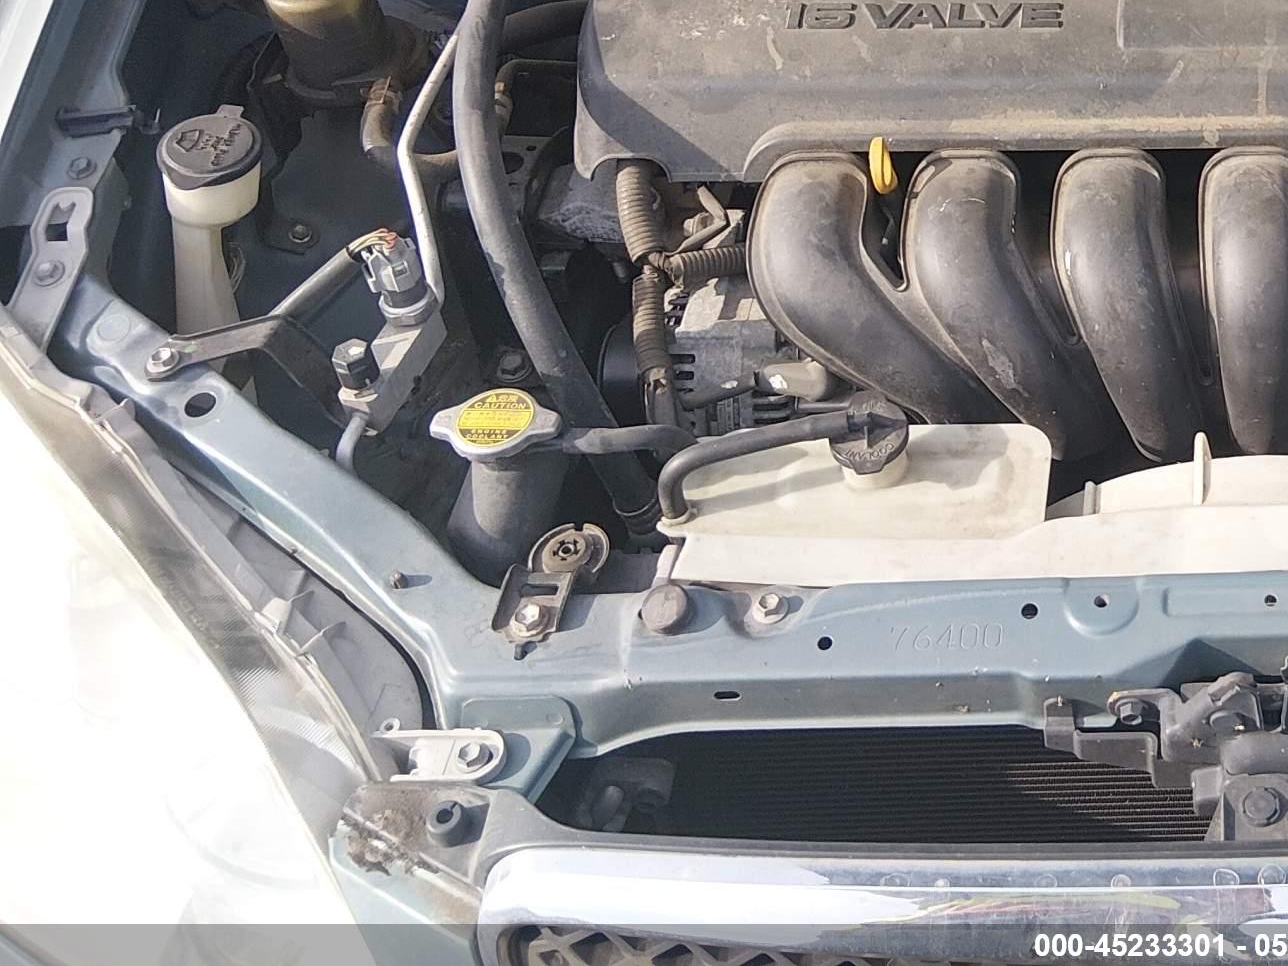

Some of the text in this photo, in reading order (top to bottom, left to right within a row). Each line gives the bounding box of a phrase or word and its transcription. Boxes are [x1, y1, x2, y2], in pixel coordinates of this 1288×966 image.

[785, 2, 1065, 30] 16 VALVE
[474, 401, 527, 409] CAUTION
